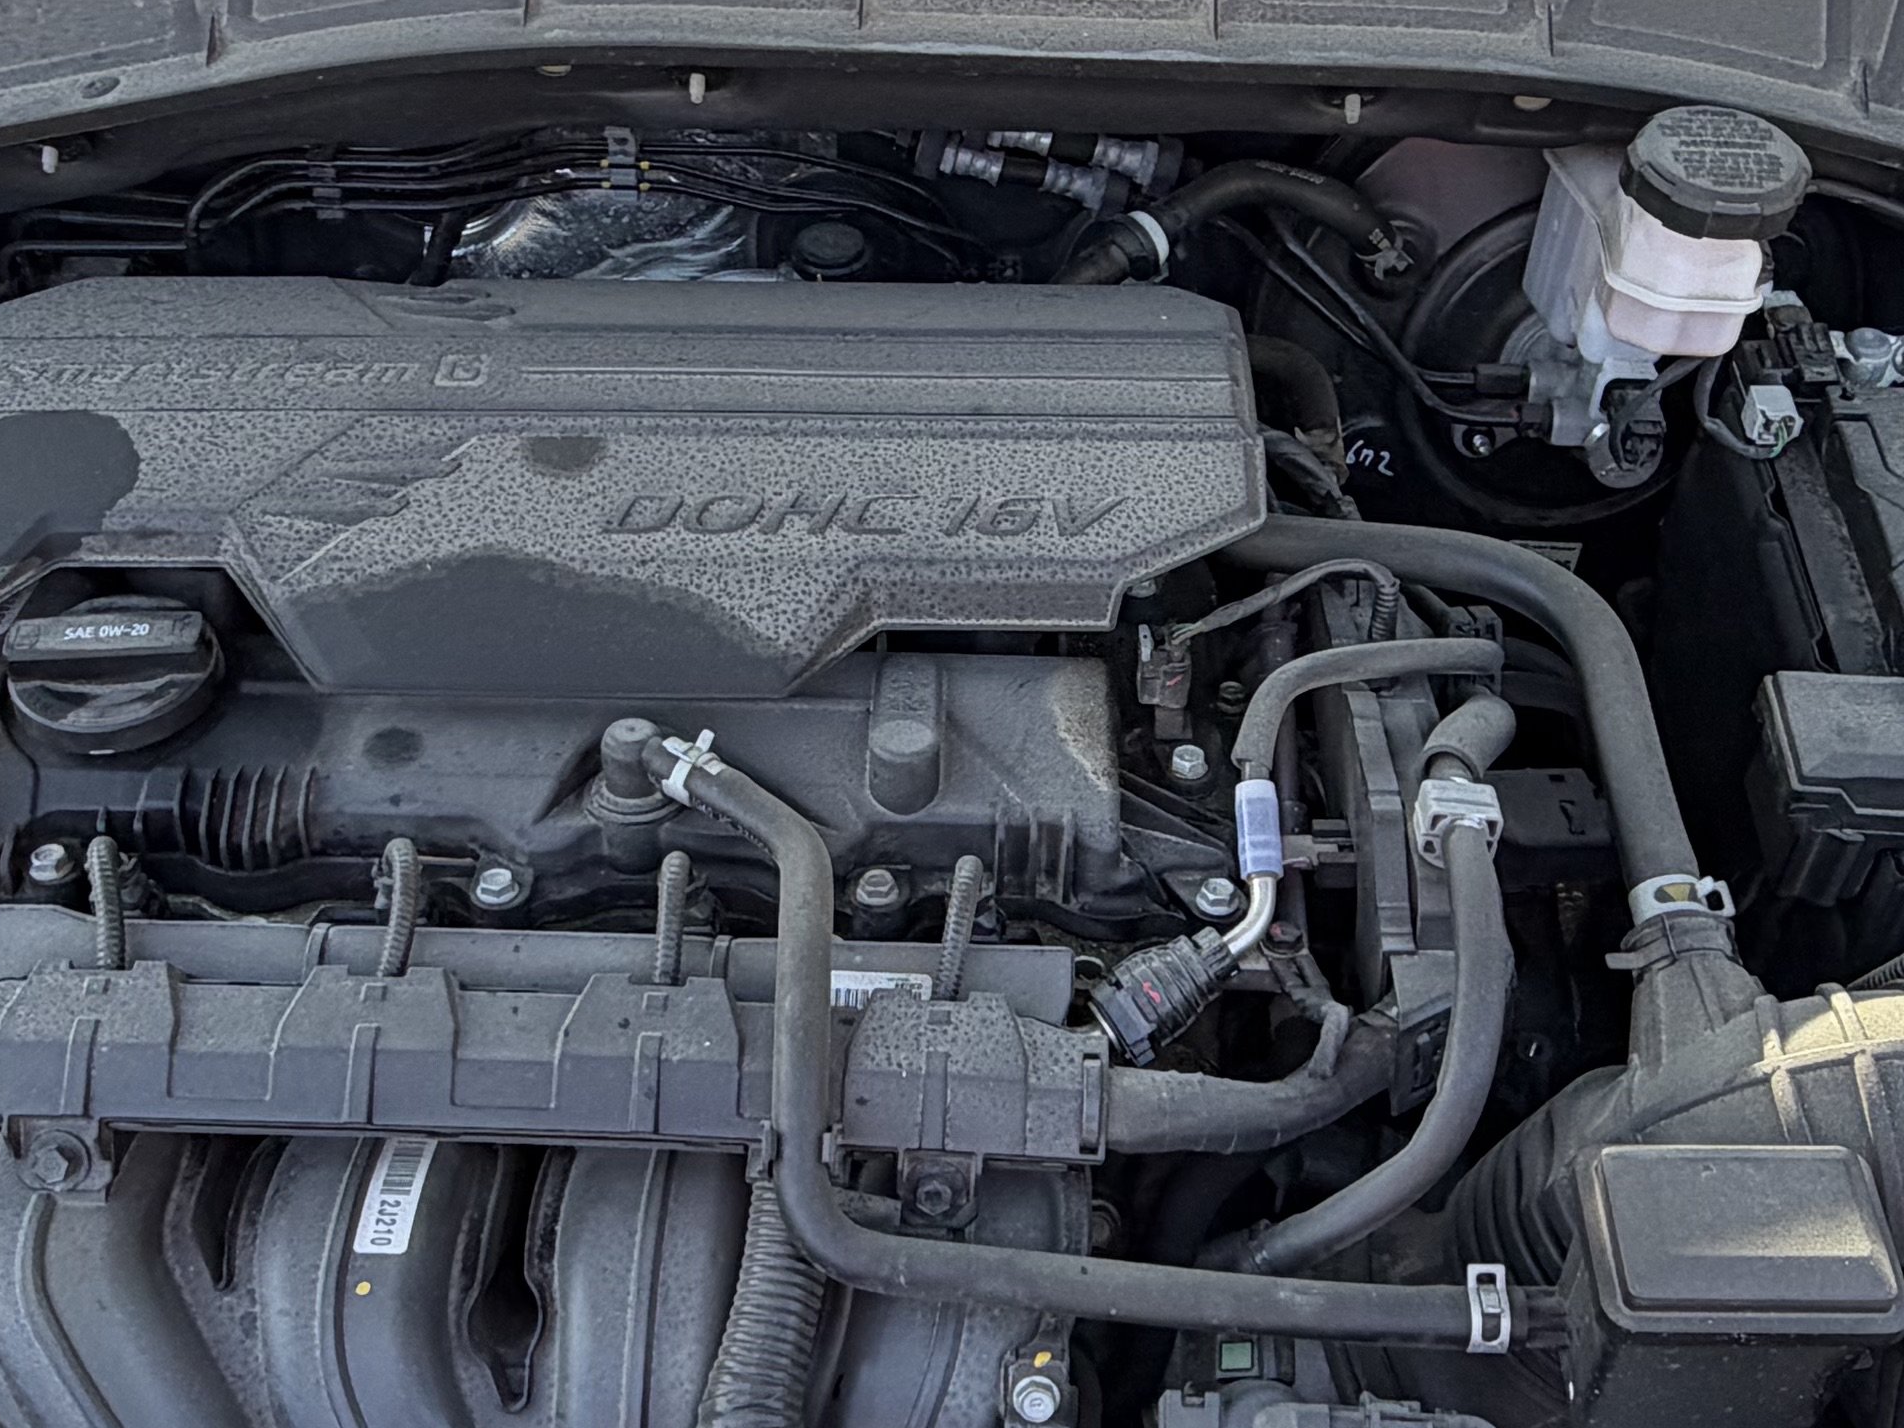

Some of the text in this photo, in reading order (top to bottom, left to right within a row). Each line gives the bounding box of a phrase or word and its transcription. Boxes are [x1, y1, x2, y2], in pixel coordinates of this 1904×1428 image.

[599, 494, 1130, 537] DOHC 16V
[63, 622, 150, 641] SAE 0W-20
[369, 1199, 402, 1246] 2J210
